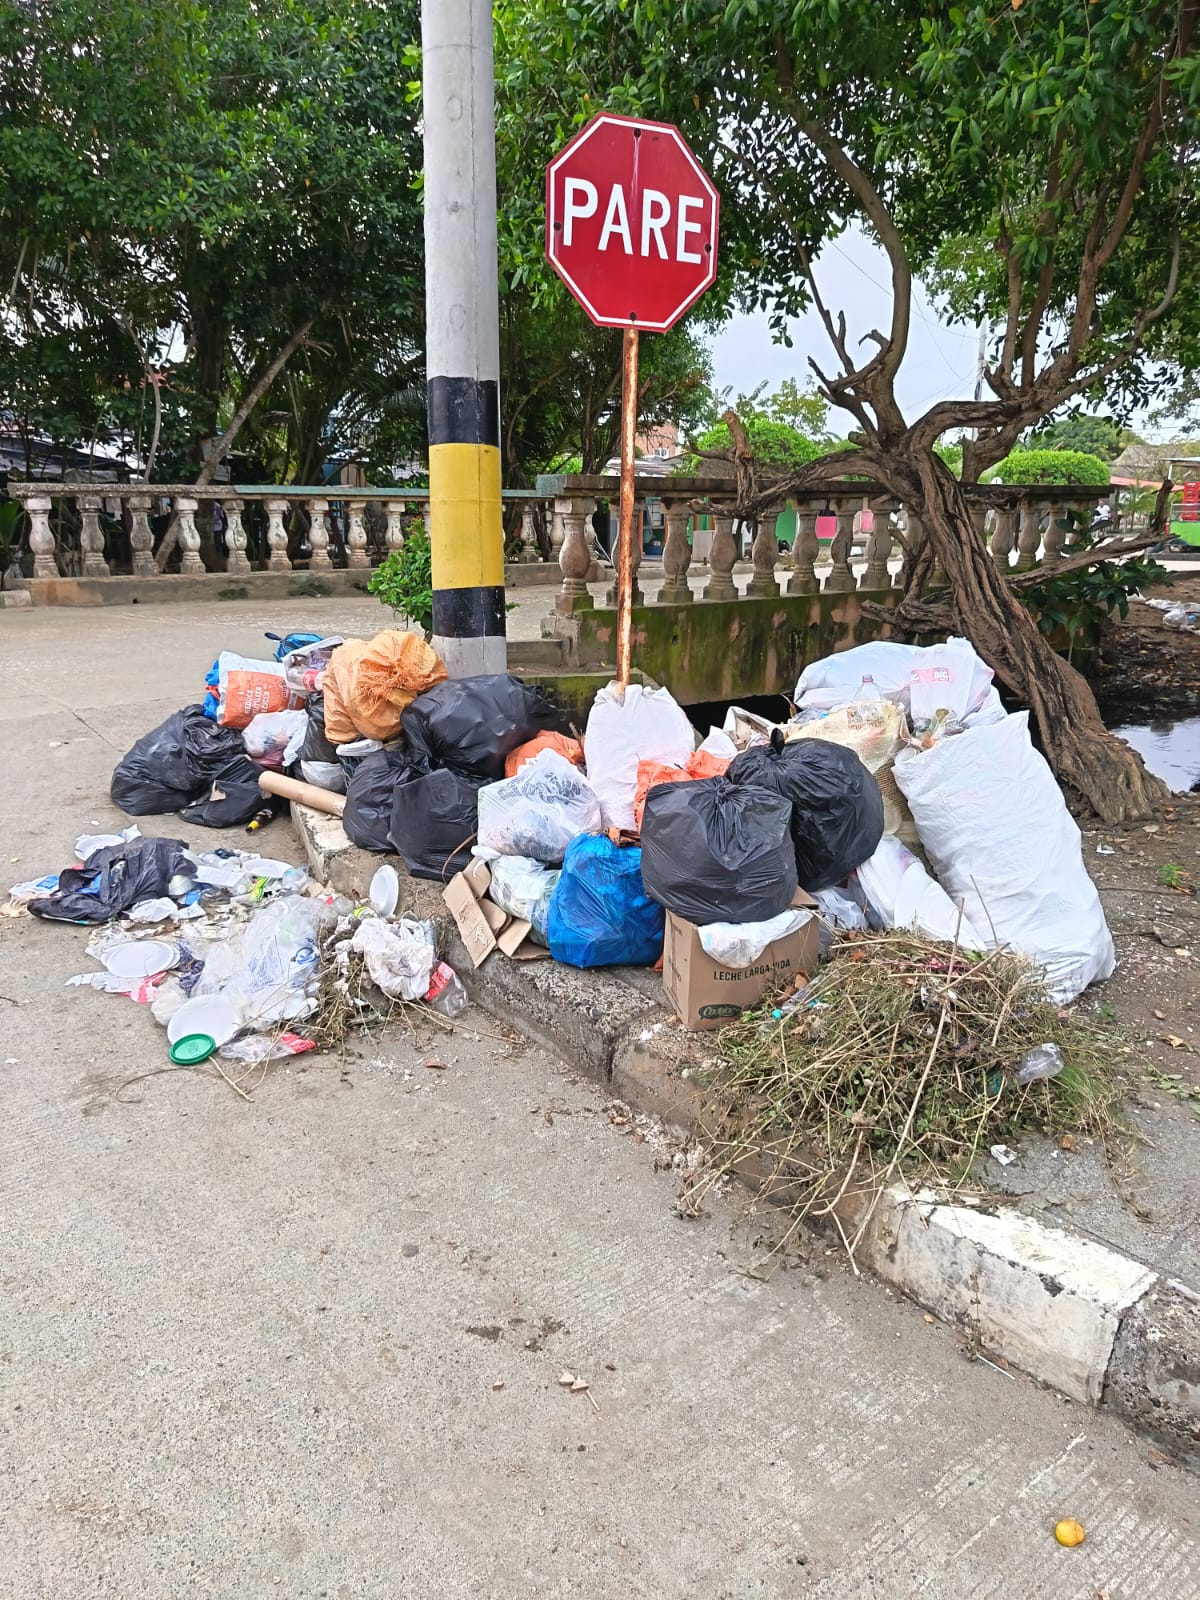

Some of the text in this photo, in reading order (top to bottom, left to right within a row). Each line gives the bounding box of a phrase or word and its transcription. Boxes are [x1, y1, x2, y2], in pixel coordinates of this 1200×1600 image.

[563, 176, 704, 264] PARE
[713, 958, 791, 982] LECHE LARGA VIDA
